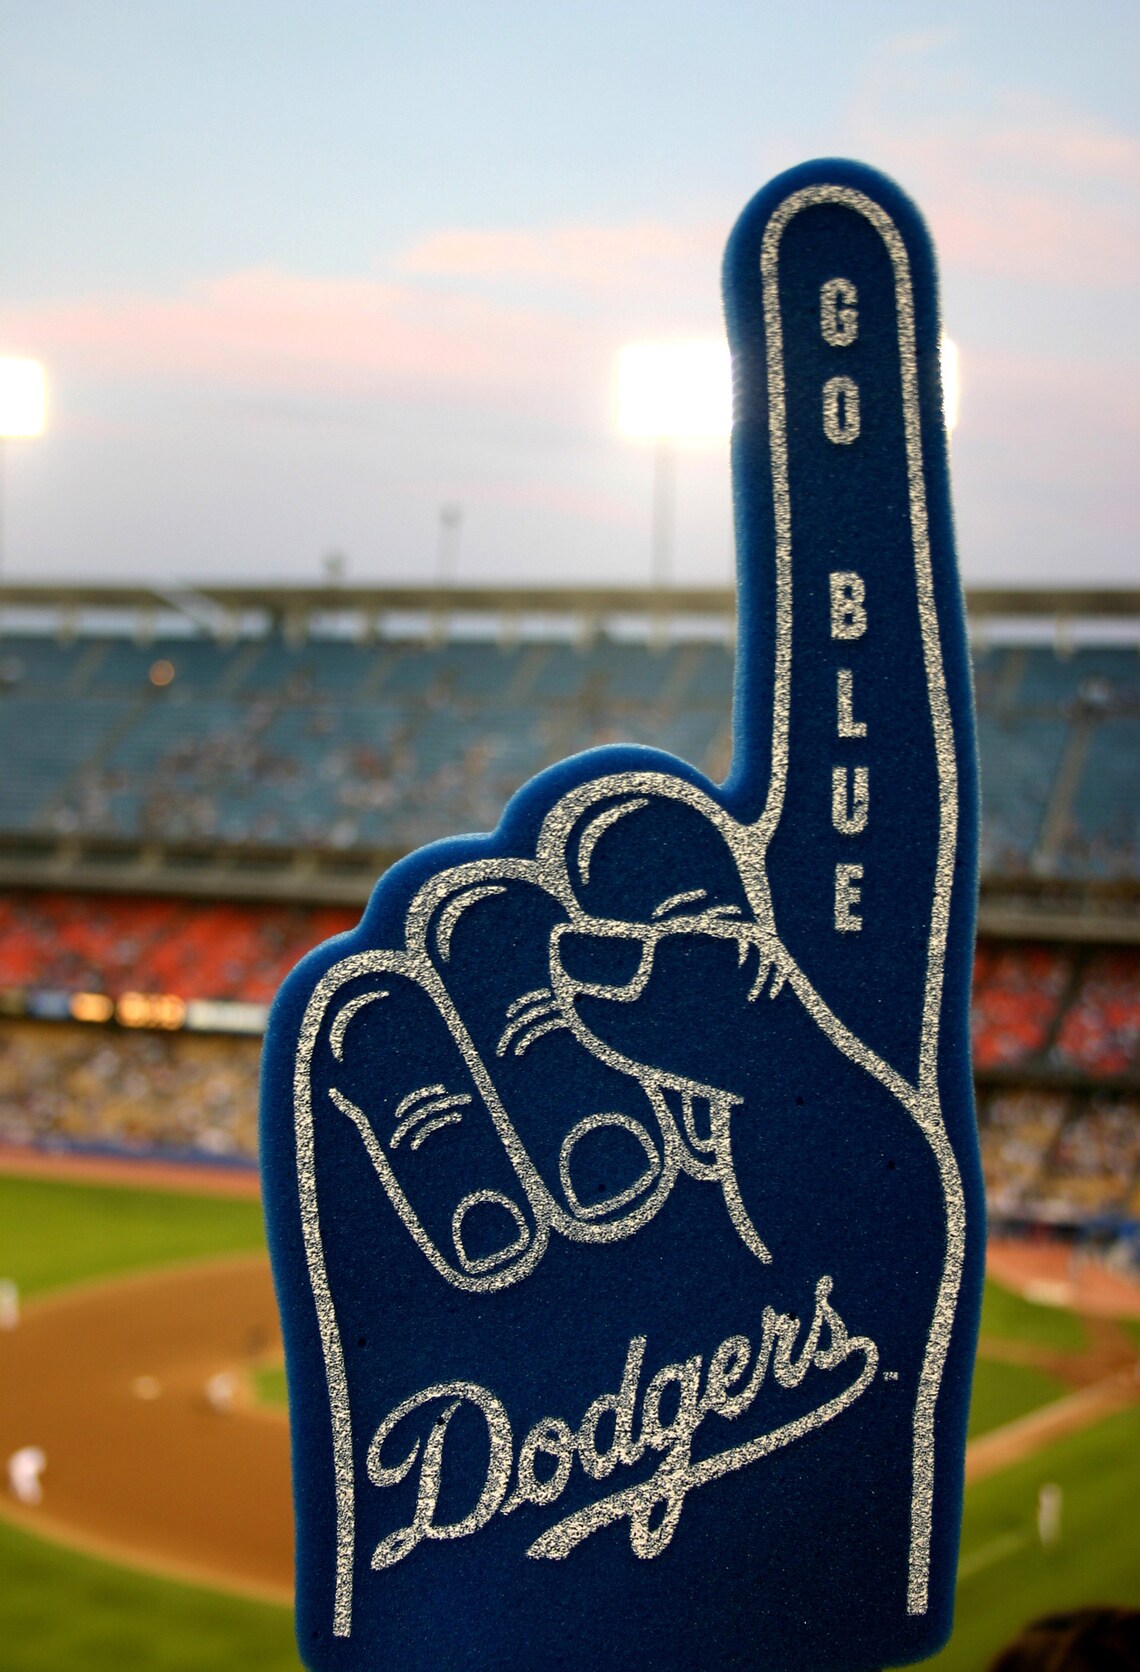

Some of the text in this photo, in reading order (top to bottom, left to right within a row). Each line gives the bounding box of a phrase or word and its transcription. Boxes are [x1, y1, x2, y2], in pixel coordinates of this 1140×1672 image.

[820, 277, 870, 935] GO BLUE
[366, 1276, 880, 1571] Dodgers
